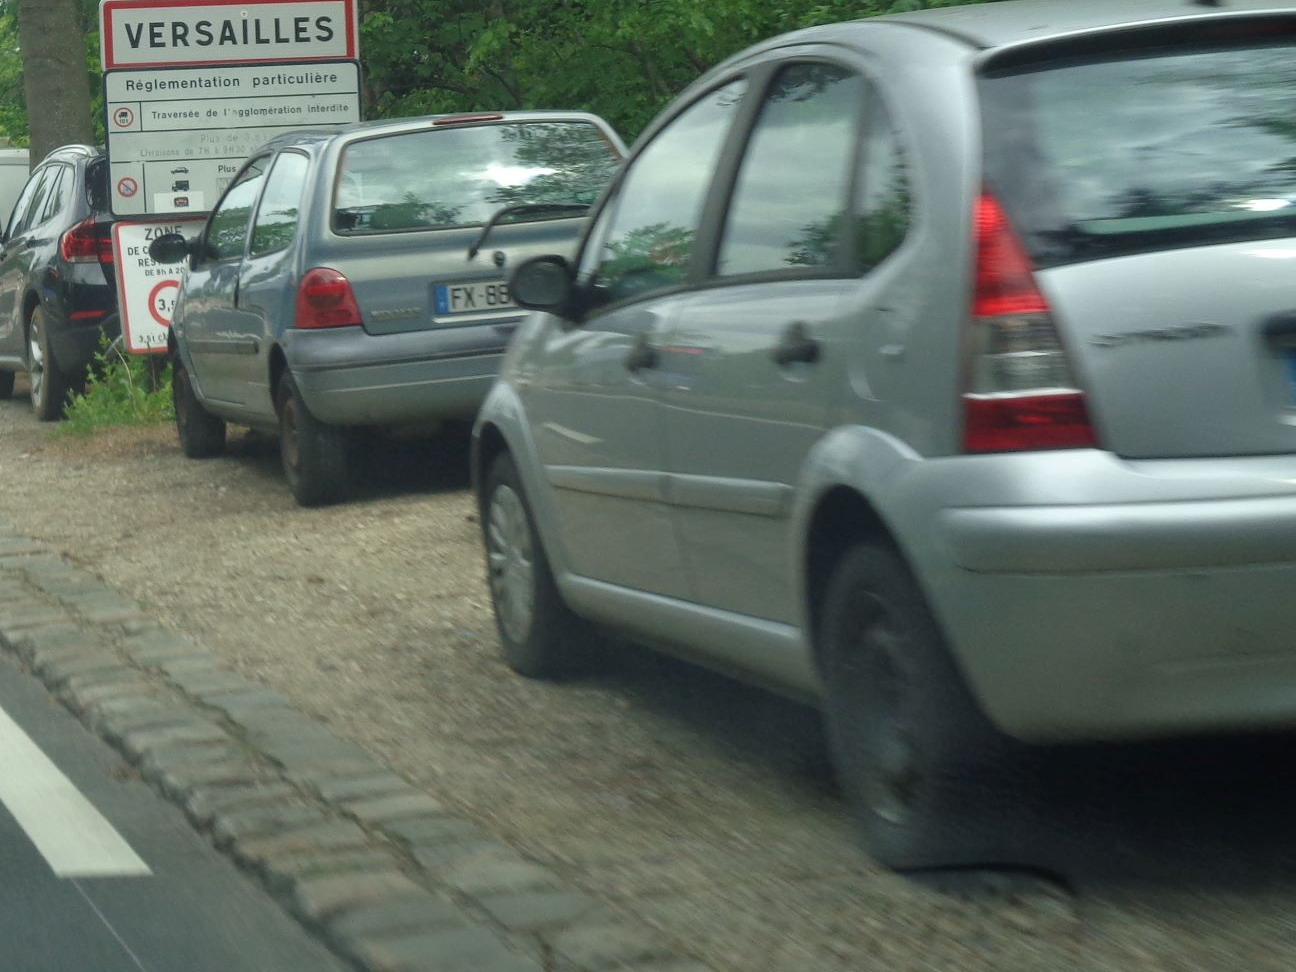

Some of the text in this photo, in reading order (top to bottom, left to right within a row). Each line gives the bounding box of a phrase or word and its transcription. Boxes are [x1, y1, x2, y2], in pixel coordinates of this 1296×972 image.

[124, 15, 334, 49] VERSAILLES
[125, 72, 337, 92] Réglementation particulière
[151, 110, 200, 120] Traversée
[206, 108, 218, 117] de
[307, 103, 349, 113] interdite
[217, 164, 237, 174] Plus
[127, 246, 140, 256] DE
[144, 269, 155, 277] DE
